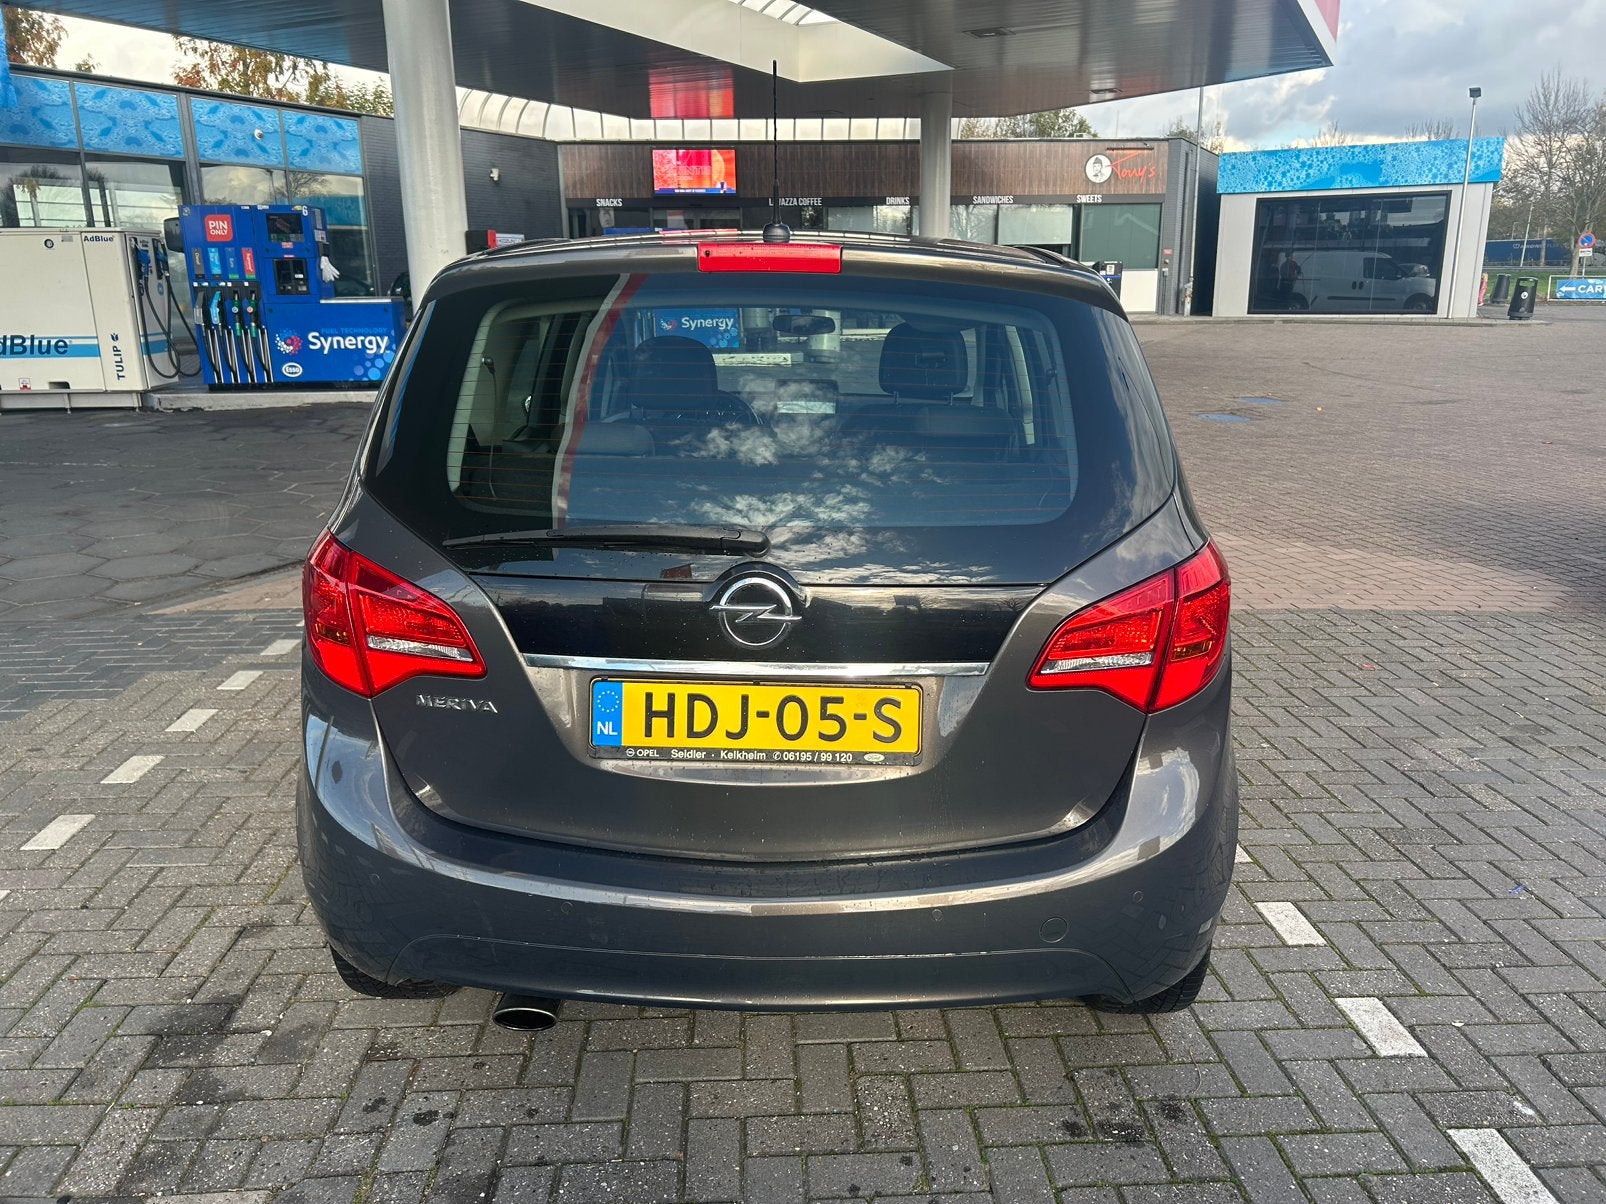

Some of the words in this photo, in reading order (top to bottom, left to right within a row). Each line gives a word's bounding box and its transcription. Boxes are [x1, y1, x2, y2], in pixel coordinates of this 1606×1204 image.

[596, 198, 623, 207] SNACKS
[769, 198, 797, 206] LAZZA
[798, 198, 823, 206] COFFEE
[886, 197, 910, 205] DRINKS
[972, 196, 1014, 204] SANDWICHES
[1077, 194, 1102, 203] SWEETS
[302, 206, 309, 216] 6
[208, 220, 228, 230] PIN
[681, 317, 734, 331] Synergy
[308, 331, 389, 355] Synergy
[113, 345, 126, 381] TULIP
[285, 366, 300, 374] Esso
[416, 694, 498, 713] MERIVA
[644, 691, 902, 743] HDJ-05-S
[597, 721, 618, 736] NL
[636, 749, 660, 758] OPEL
[671, 748, 706, 759] Seidler
[720, 749, 766, 761] Kelkheim
[783, 751, 812, 762] 06195
[820, 752, 833, 762] 99
[835, 752, 853, 762] 120
